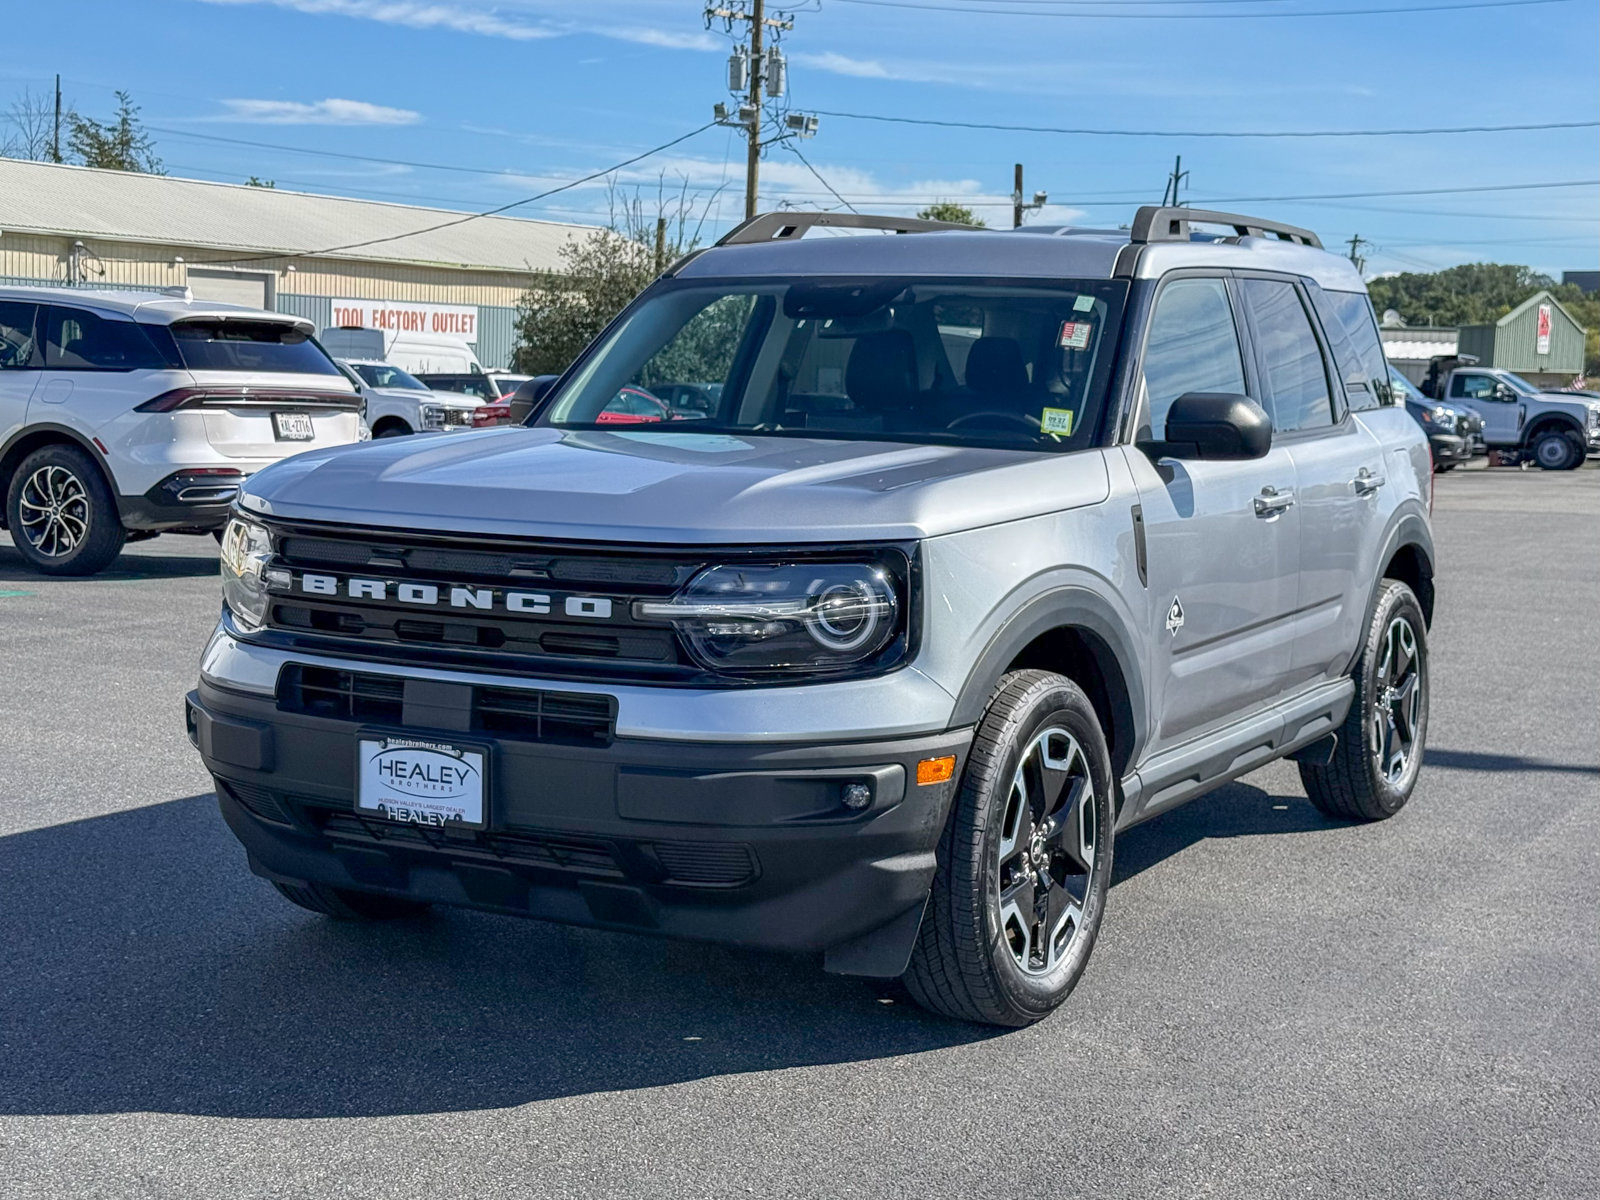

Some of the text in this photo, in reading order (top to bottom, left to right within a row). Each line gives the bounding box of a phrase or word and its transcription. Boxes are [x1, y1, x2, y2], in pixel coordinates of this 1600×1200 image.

[334, 307, 475, 334] TOOL FACTORY OUTLET
[302, 574, 612, 618] BRONCO
[387, 737, 453, 750] healeybrothers.com
[379, 758, 470, 786] HEALEY
[390, 780, 453, 793] BROTHERS
[378, 798, 399, 806] HUDSON
[423, 803, 445, 812] LARGEST
[446, 806, 466, 814] DEALER
[388, 807, 448, 827] HEALEY
